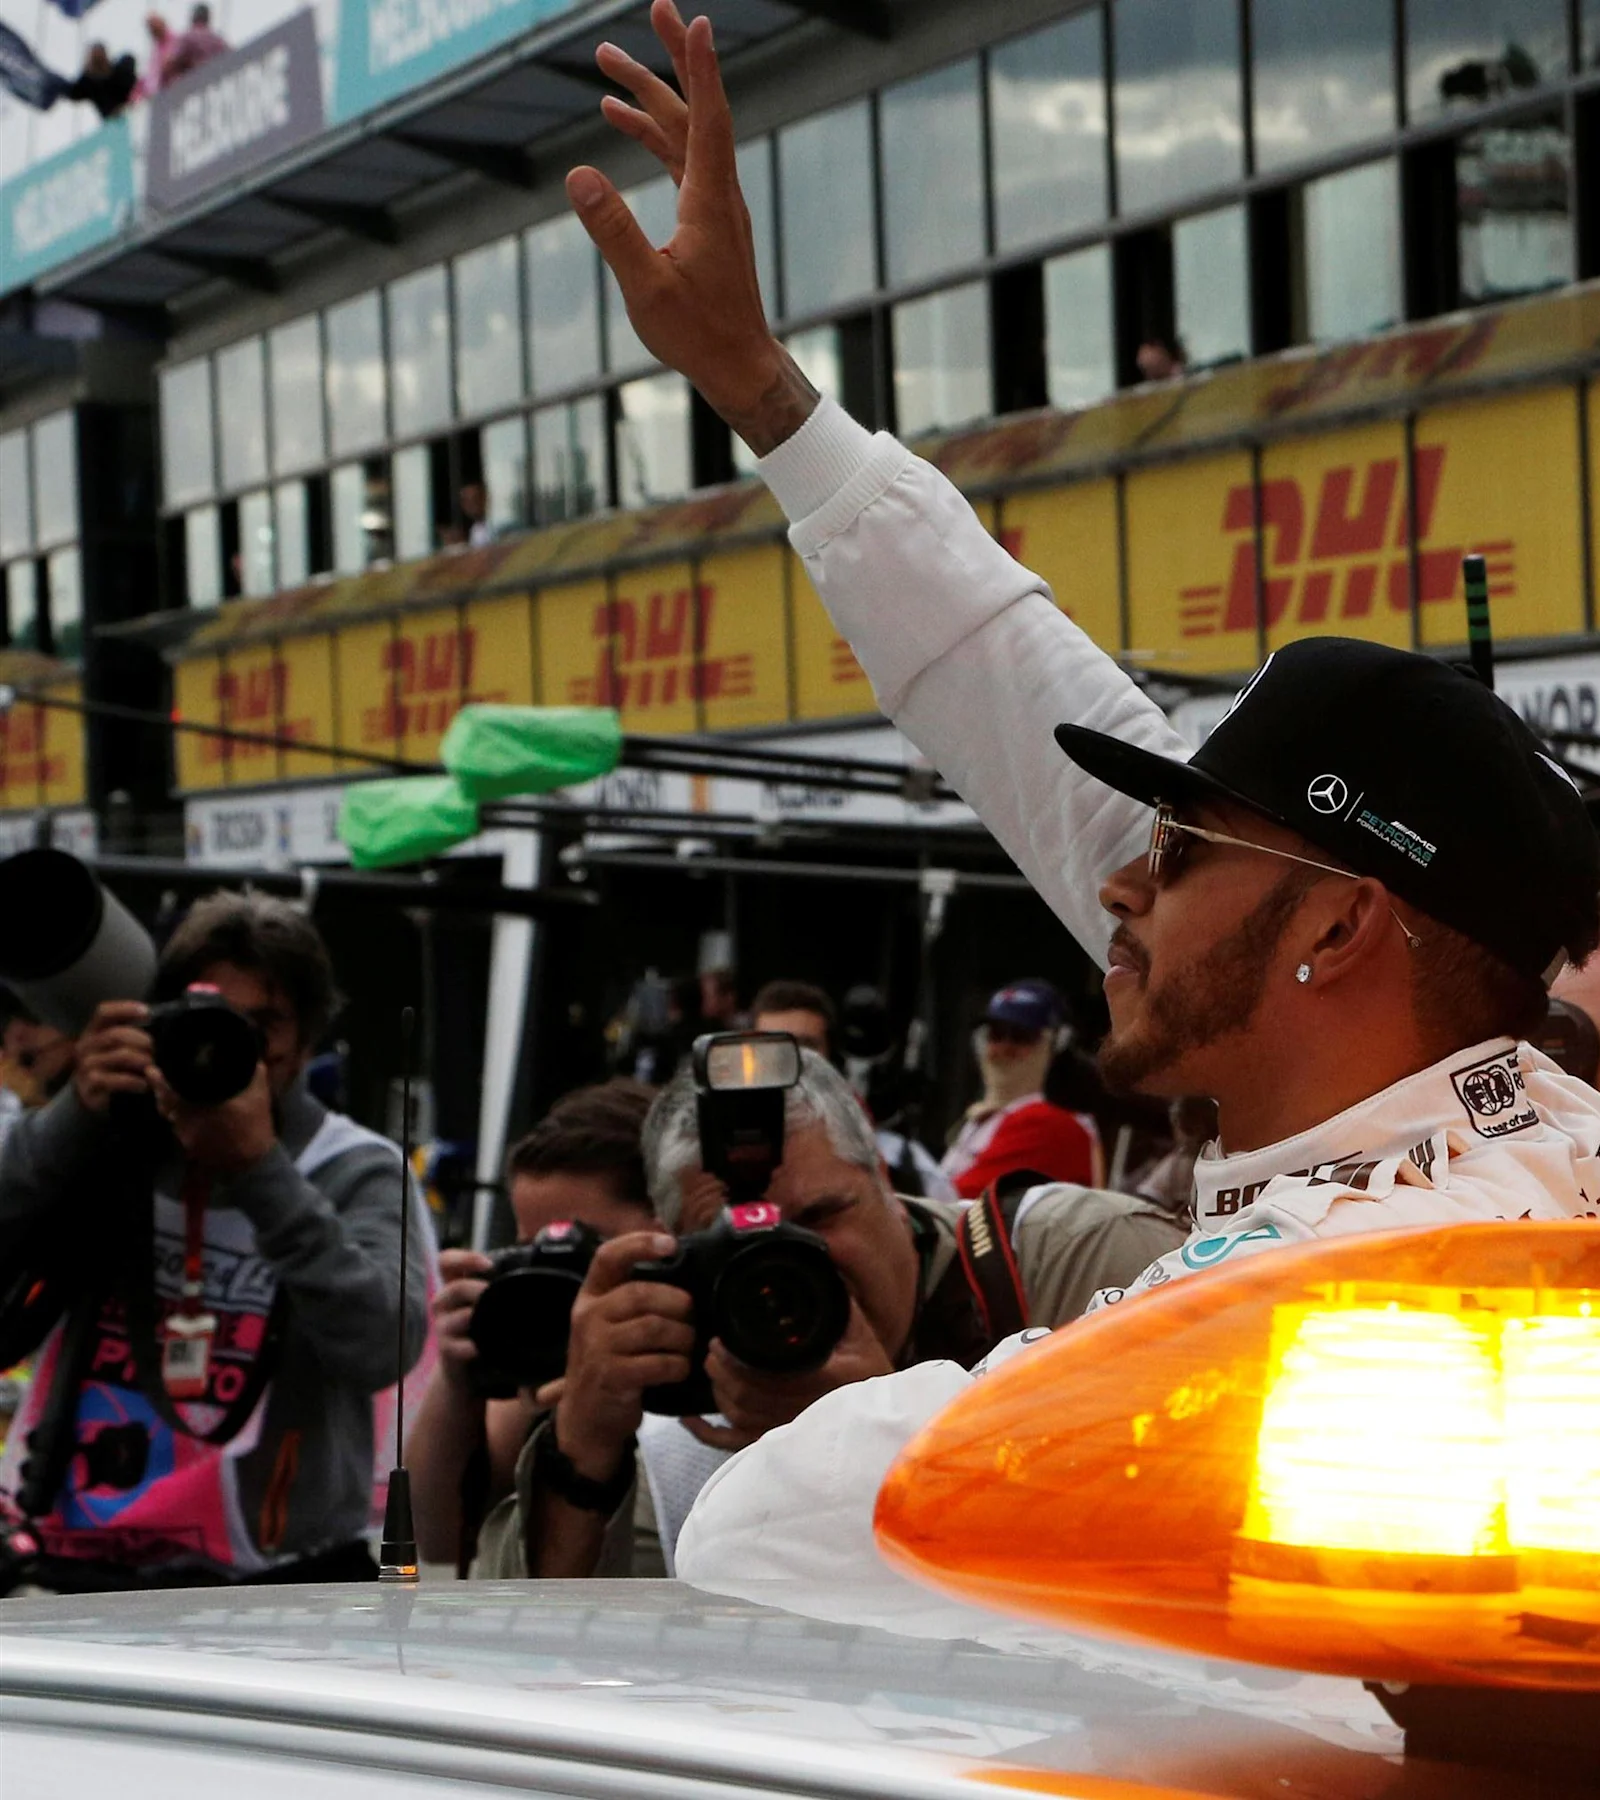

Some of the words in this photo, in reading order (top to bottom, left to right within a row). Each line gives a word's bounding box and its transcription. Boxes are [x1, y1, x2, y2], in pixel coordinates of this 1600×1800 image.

[1222, 444, 1464, 632] DHL
[592, 584, 724, 711] DHL
[1502, 683, 1597, 750] NOR
[1356, 817, 1390, 843] FORMULA
[1390, 839, 1406, 853] ONE
[1407, 851, 1428, 868] TEAM
[1360, 810, 1433, 862] PETRONAS
